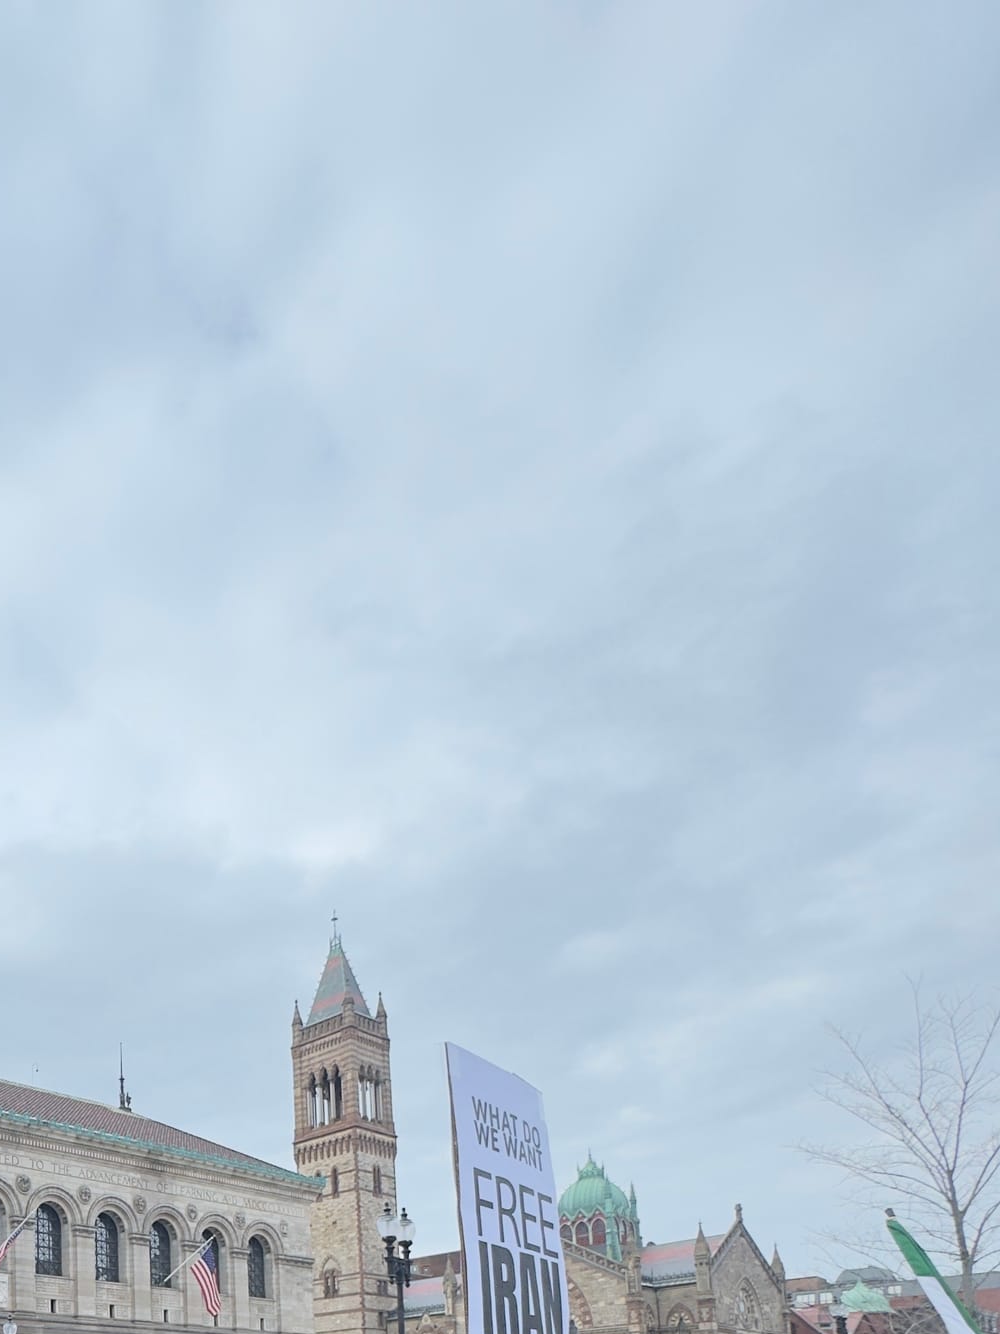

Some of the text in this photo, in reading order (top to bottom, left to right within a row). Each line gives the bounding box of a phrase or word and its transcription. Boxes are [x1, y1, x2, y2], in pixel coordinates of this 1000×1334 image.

[472, 1096, 541, 1149] WHAT DO
[474, 1120, 543, 1171] WE WANT
[29, 1158, 45, 1170] TO
[51, 1162, 71, 1174] THE
[79, 1168, 151, 1189] ADVANCEMENT
[156, 1183, 169, 1193] OF
[473, 1167, 558, 1259] FREE
